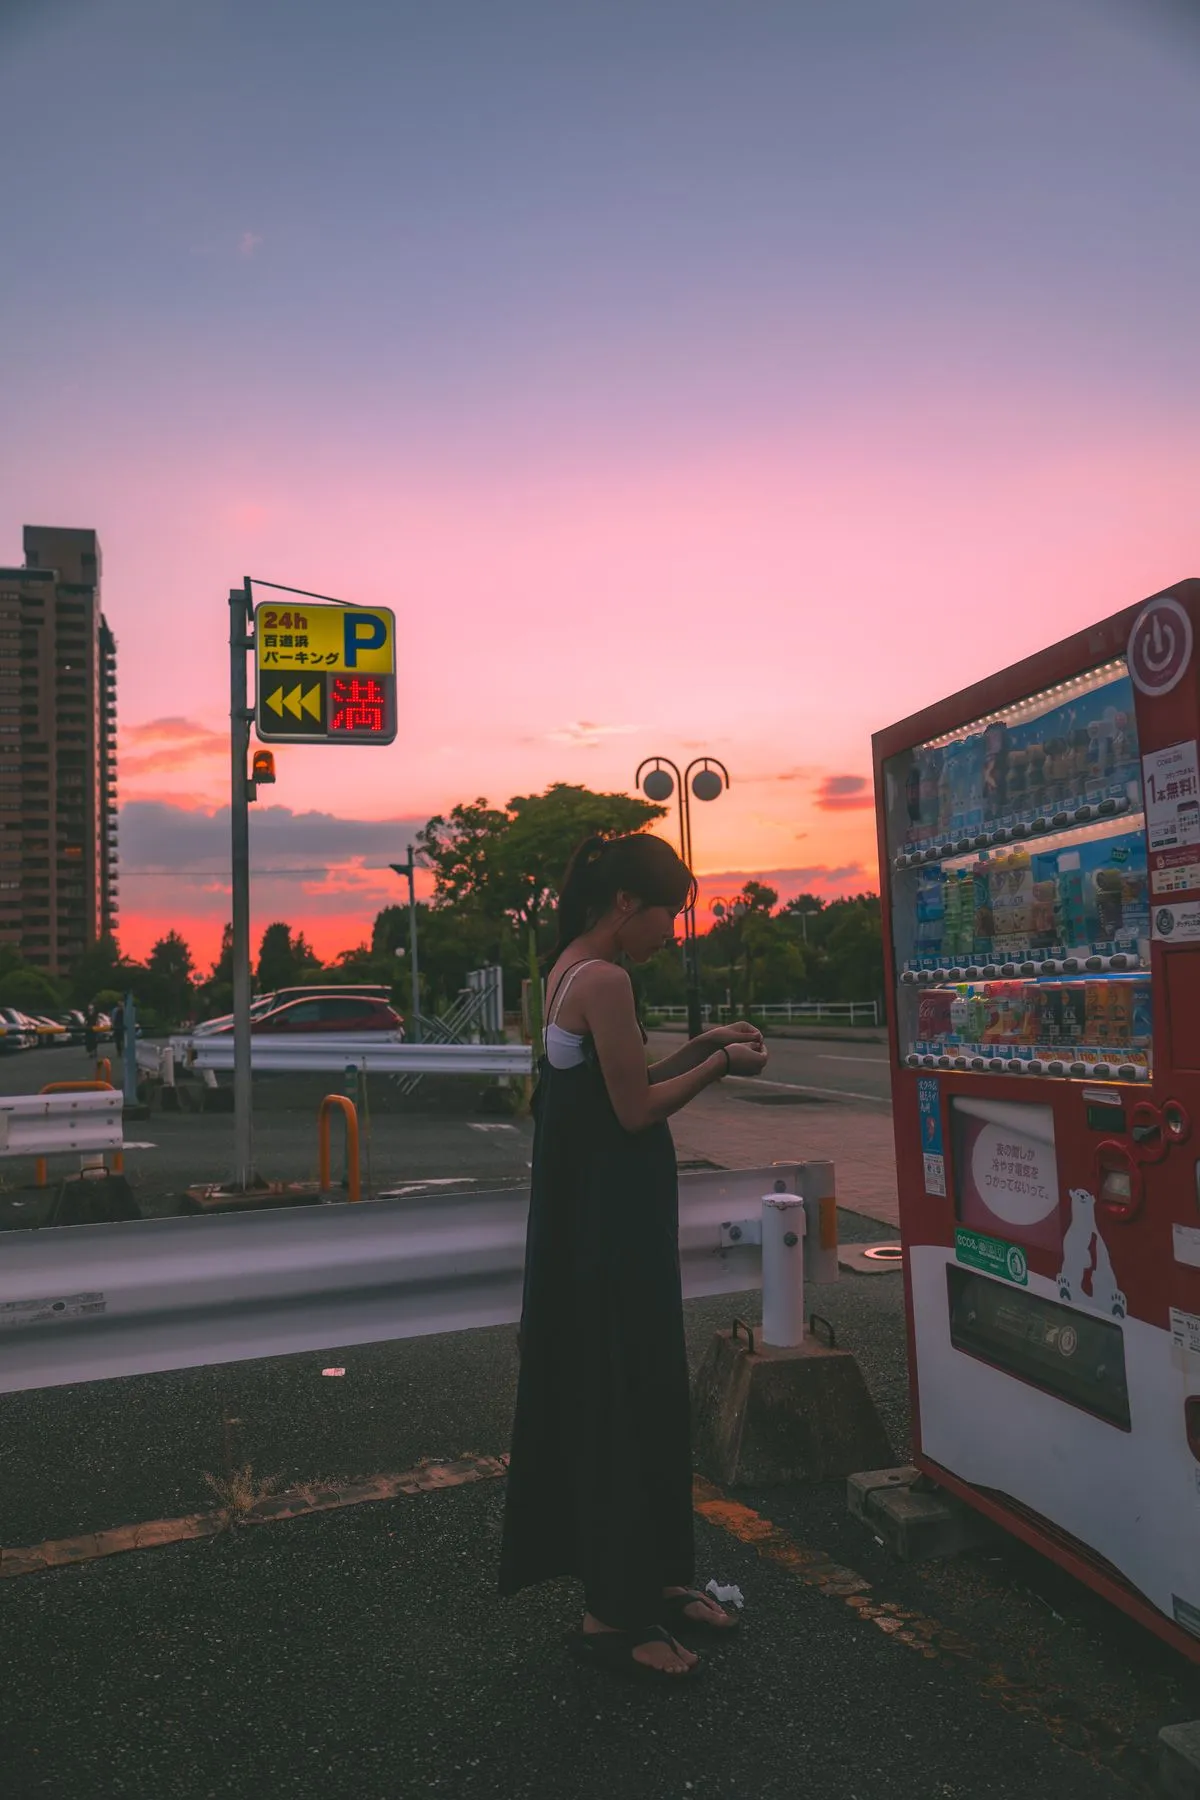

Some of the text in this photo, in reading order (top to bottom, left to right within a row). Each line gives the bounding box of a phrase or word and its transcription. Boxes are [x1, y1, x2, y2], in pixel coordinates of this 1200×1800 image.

[264, 612, 308, 630] 24h
[263, 634, 309, 648] 百道浜
[343, 612, 387, 668] P
[263, 651, 340, 665] パーキング
[330, 679, 384, 731] 満
